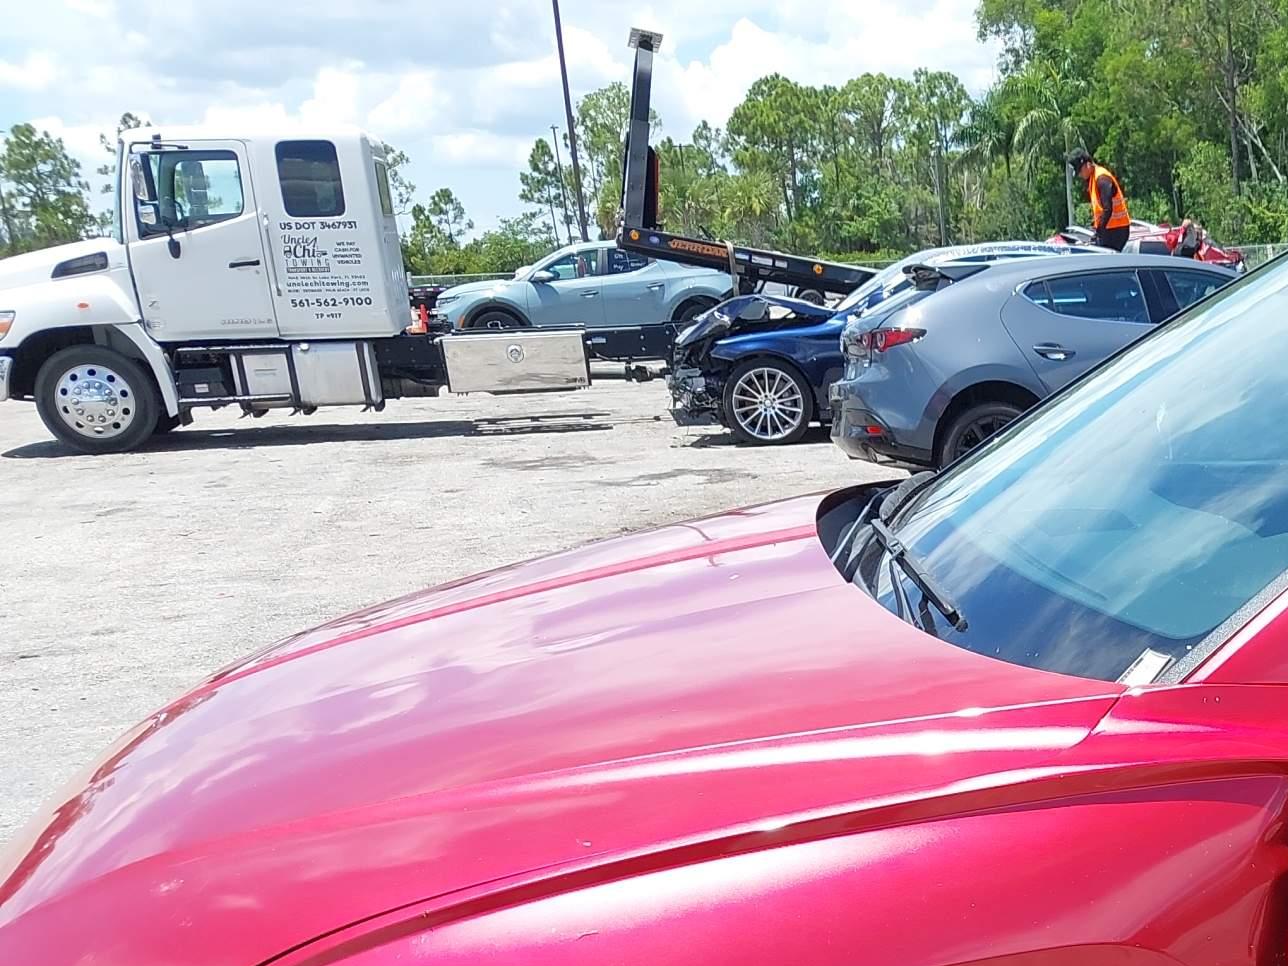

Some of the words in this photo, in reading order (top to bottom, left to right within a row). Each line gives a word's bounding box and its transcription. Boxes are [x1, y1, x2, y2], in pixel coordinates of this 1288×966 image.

[279, 222, 293, 230] US
[294, 222, 316, 230] DOT
[320, 221, 357, 230] 3467931
[281, 234, 310, 244] Uncle
[293, 243, 316, 258] Chi
[287, 279, 369, 288] unclechitowing.com
[291, 297, 372, 307] 561-562-9100
